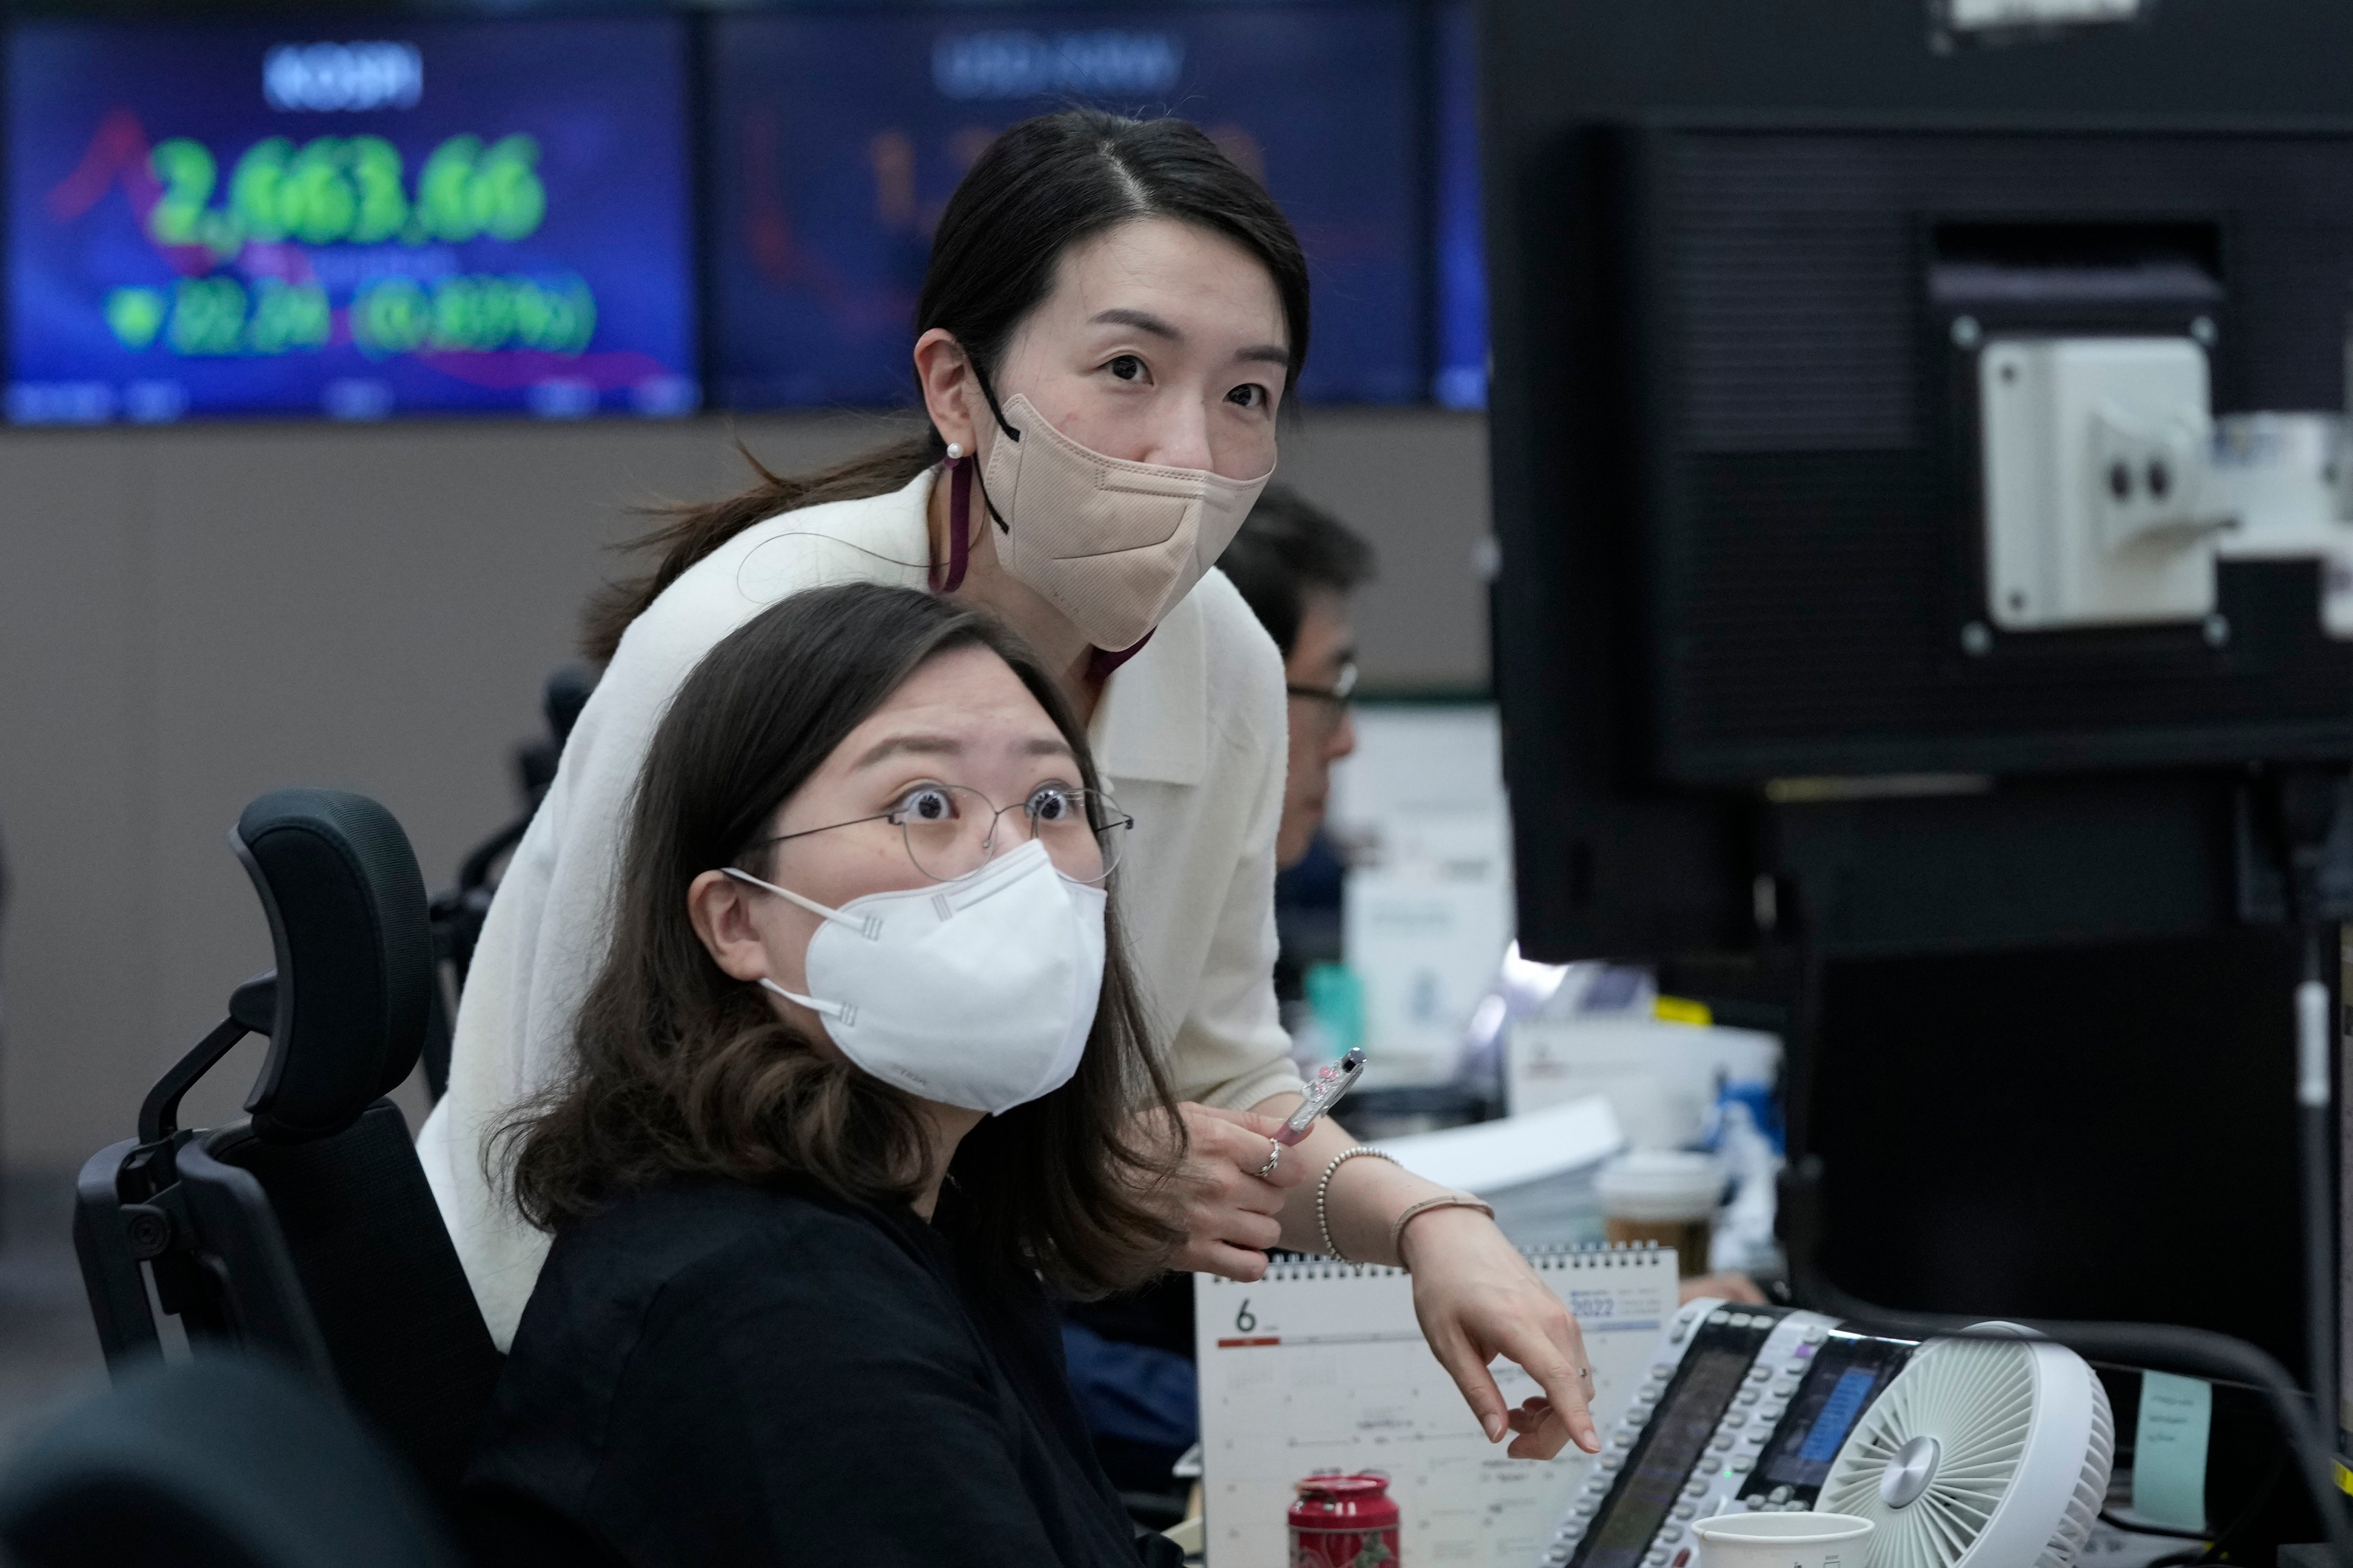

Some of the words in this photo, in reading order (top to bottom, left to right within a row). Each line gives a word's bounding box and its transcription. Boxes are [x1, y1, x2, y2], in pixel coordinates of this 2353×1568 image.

[265, 43, 422, 109] KOSPI
[151, 135, 545, 257] 2,663.66
[1236, 1297, 1256, 1333] 6
[1570, 1298, 1614, 1318] 2022
